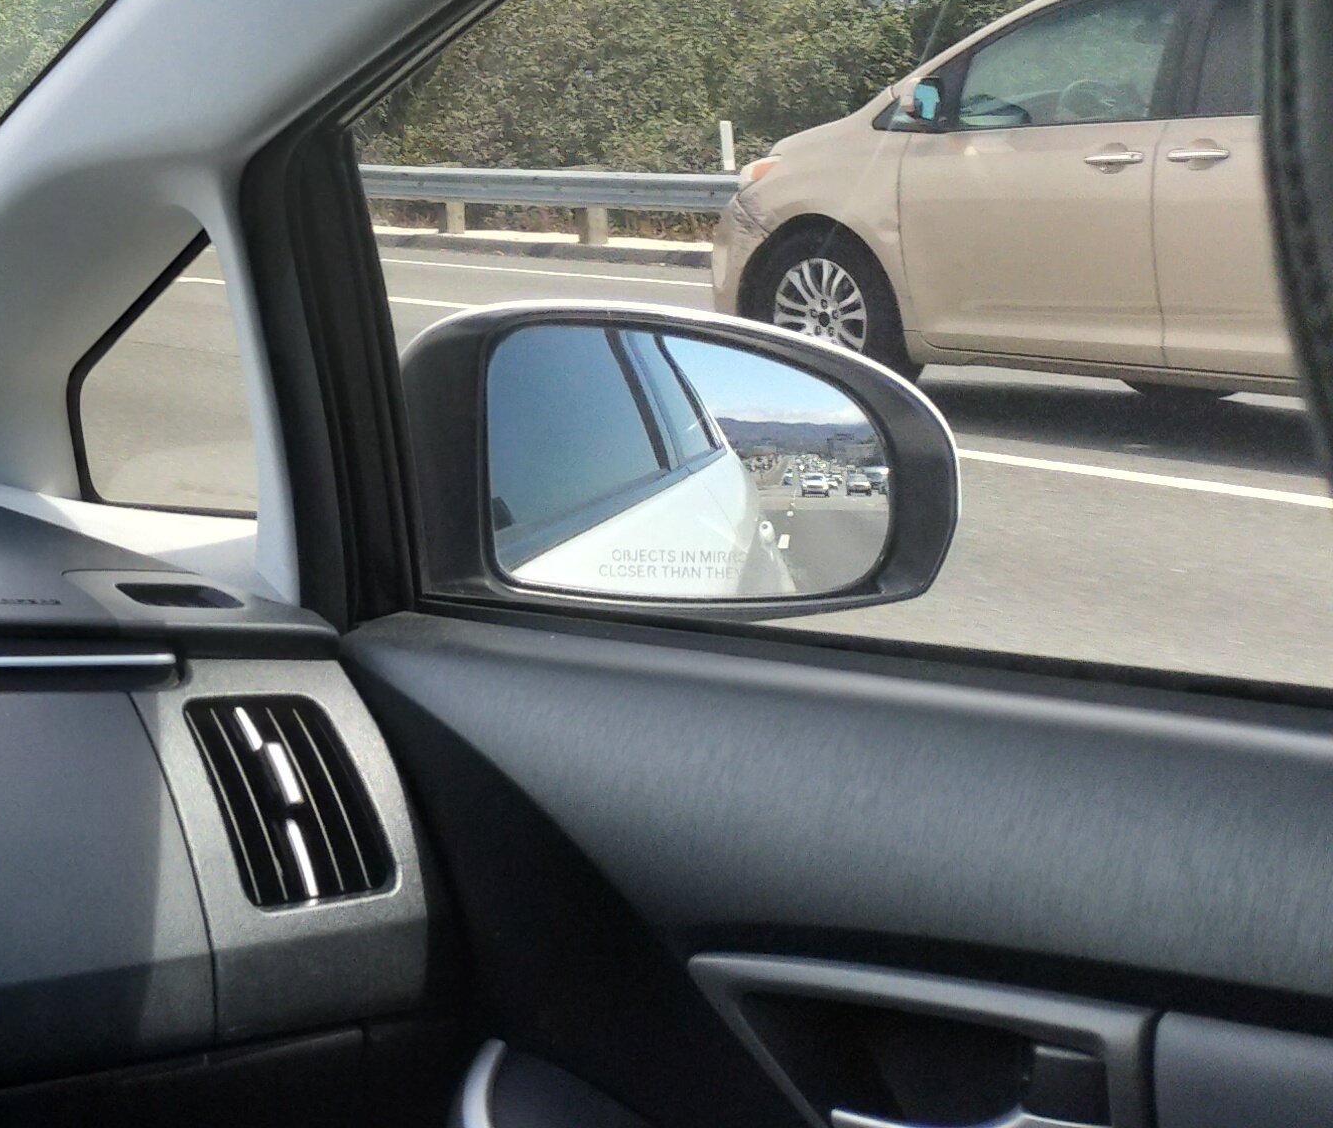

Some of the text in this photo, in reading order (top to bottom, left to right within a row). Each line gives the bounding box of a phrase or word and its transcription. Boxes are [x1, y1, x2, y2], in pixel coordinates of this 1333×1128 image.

[612, 549, 676, 563] OBJECTS
[682, 551, 696, 563] IN
[599, 564, 657, 578] CLOSER
[661, 566, 701, 579] THAN
